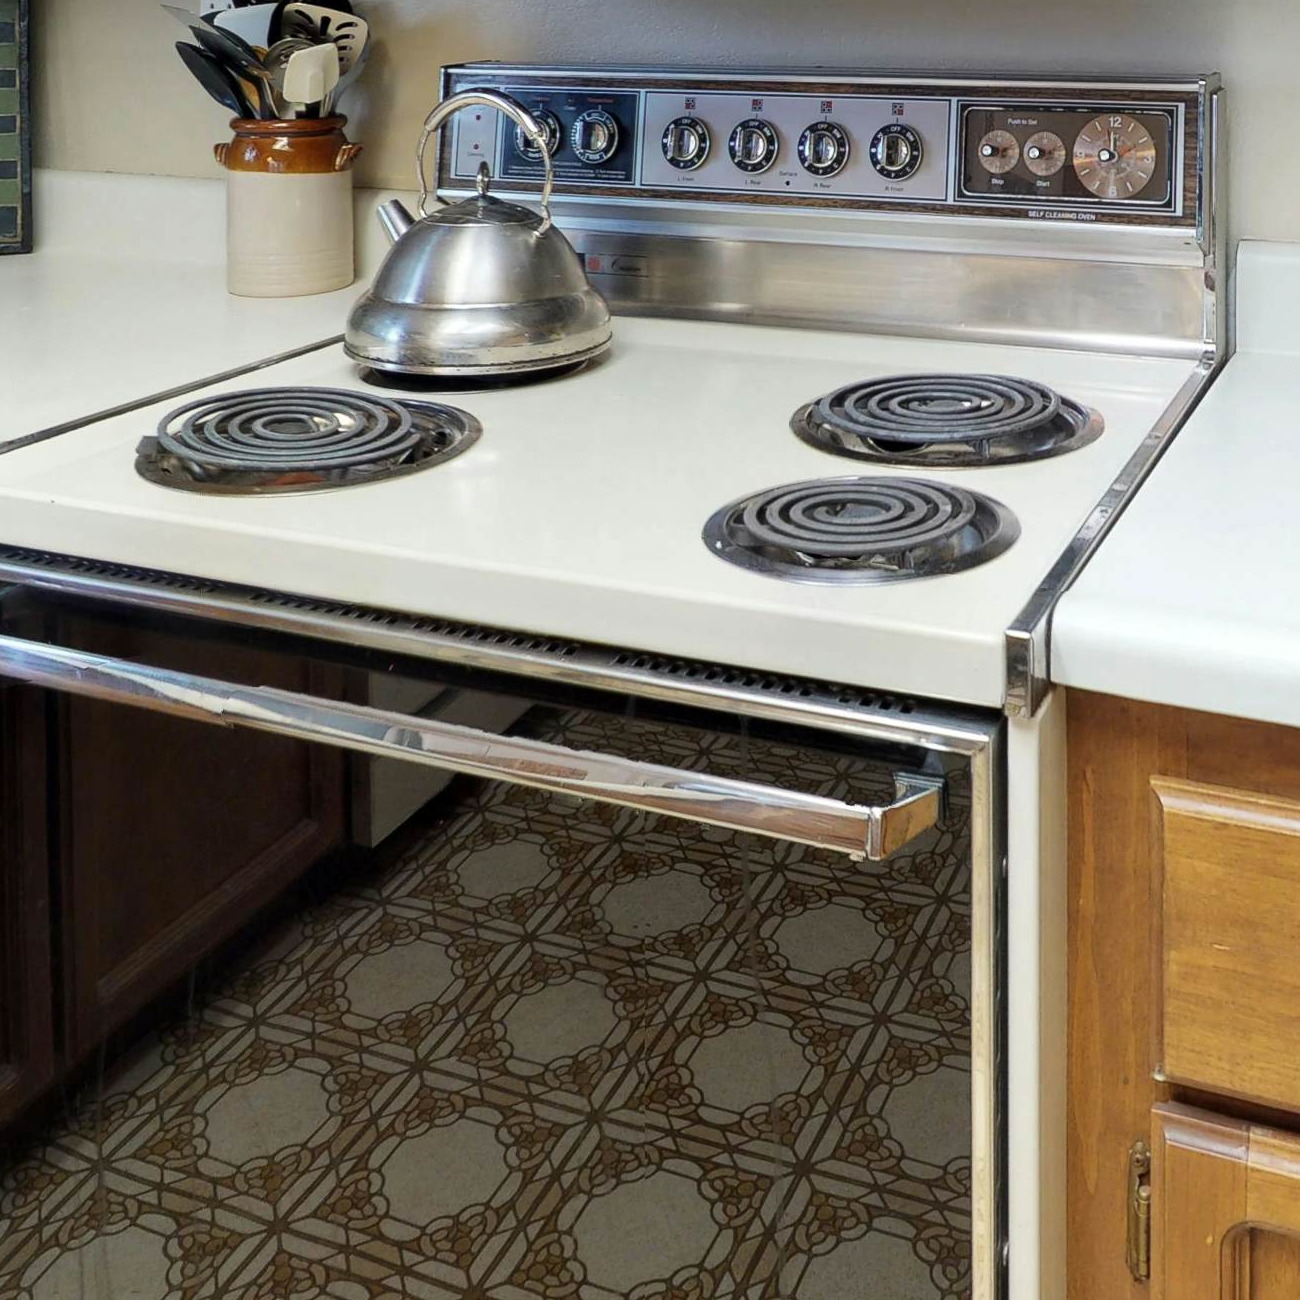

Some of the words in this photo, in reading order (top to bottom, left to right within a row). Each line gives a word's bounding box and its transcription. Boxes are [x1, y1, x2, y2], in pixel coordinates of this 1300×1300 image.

[1007, 118, 1021, 126] Push
[1109, 115, 1122, 128] 12
[1035, 180, 1051, 188] Start
[1028, 210, 1045, 218] SELF
[1045, 211, 1077, 220] CLEANING
[1077, 212, 1096, 221] OVEN
